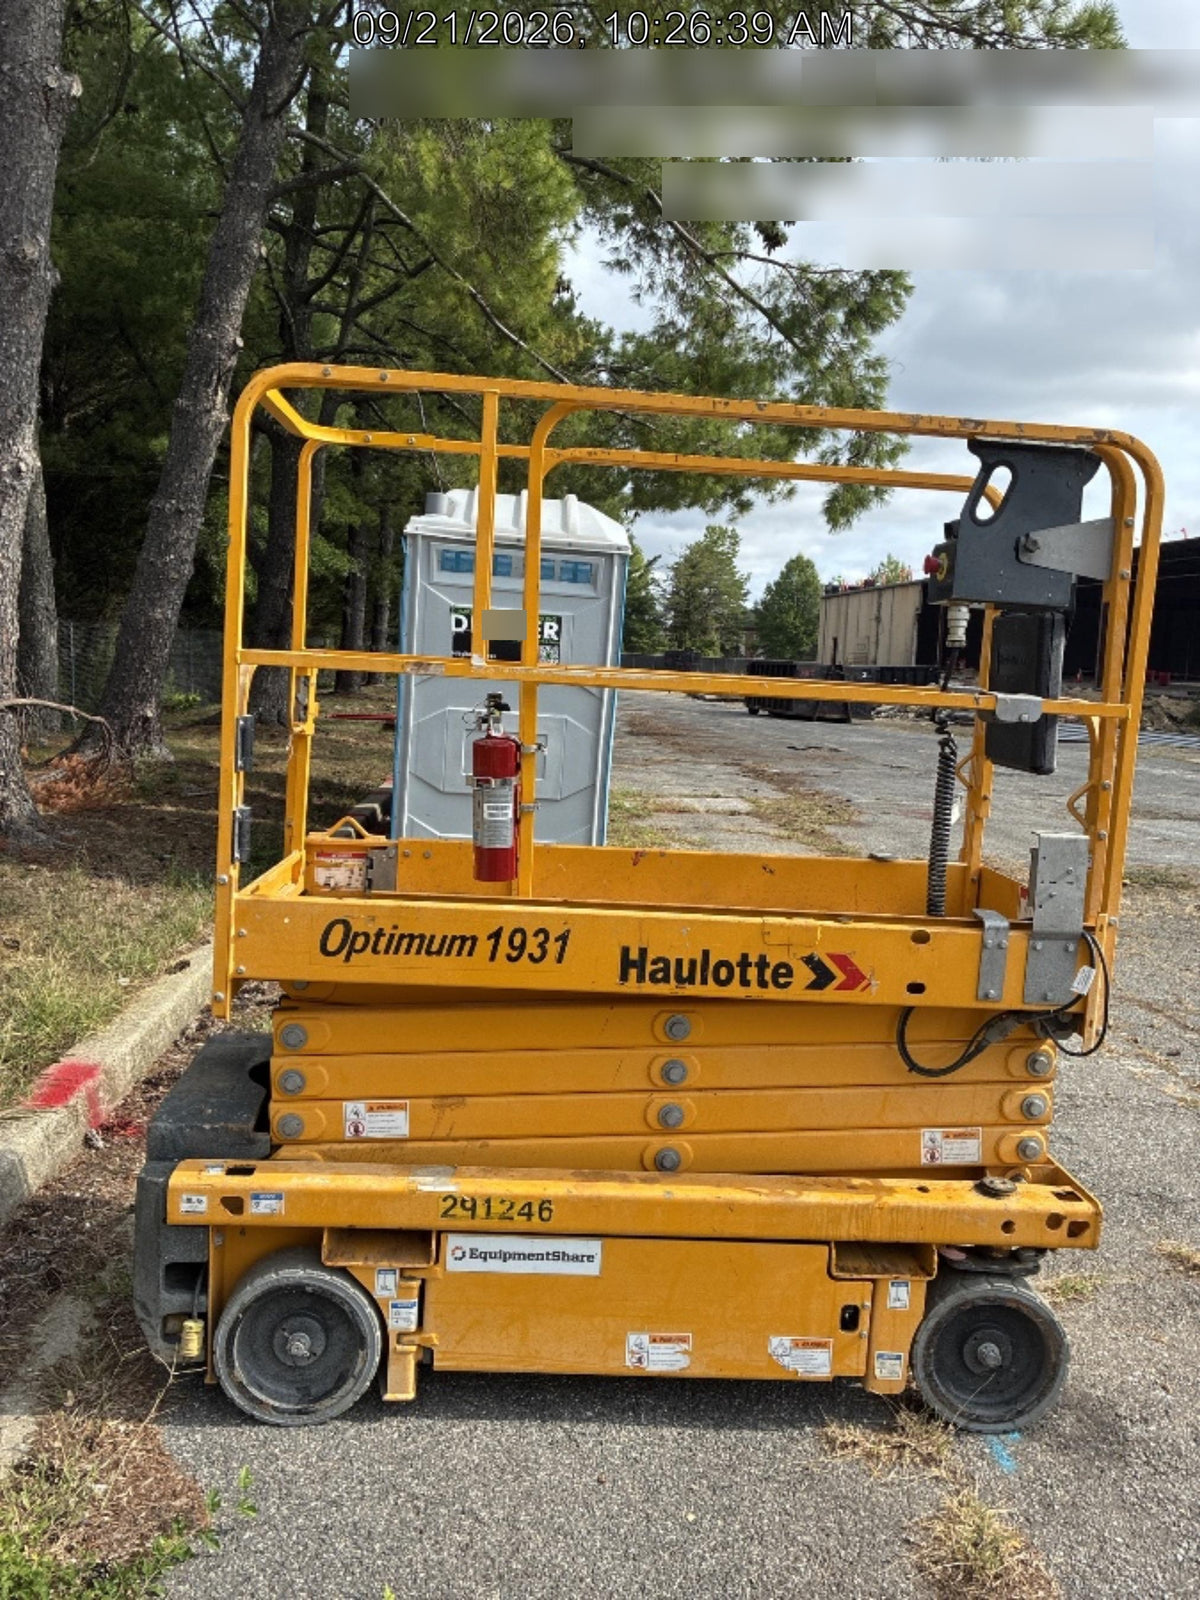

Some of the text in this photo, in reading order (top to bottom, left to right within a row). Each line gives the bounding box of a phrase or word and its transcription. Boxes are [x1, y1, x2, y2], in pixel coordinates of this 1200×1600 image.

[319, 918, 571, 965] Optimum 1931
[619, 946, 794, 989] Haulotte
[440, 1194, 554, 1222] 291246
[468, 1247, 595, 1263] EquipmentShare
